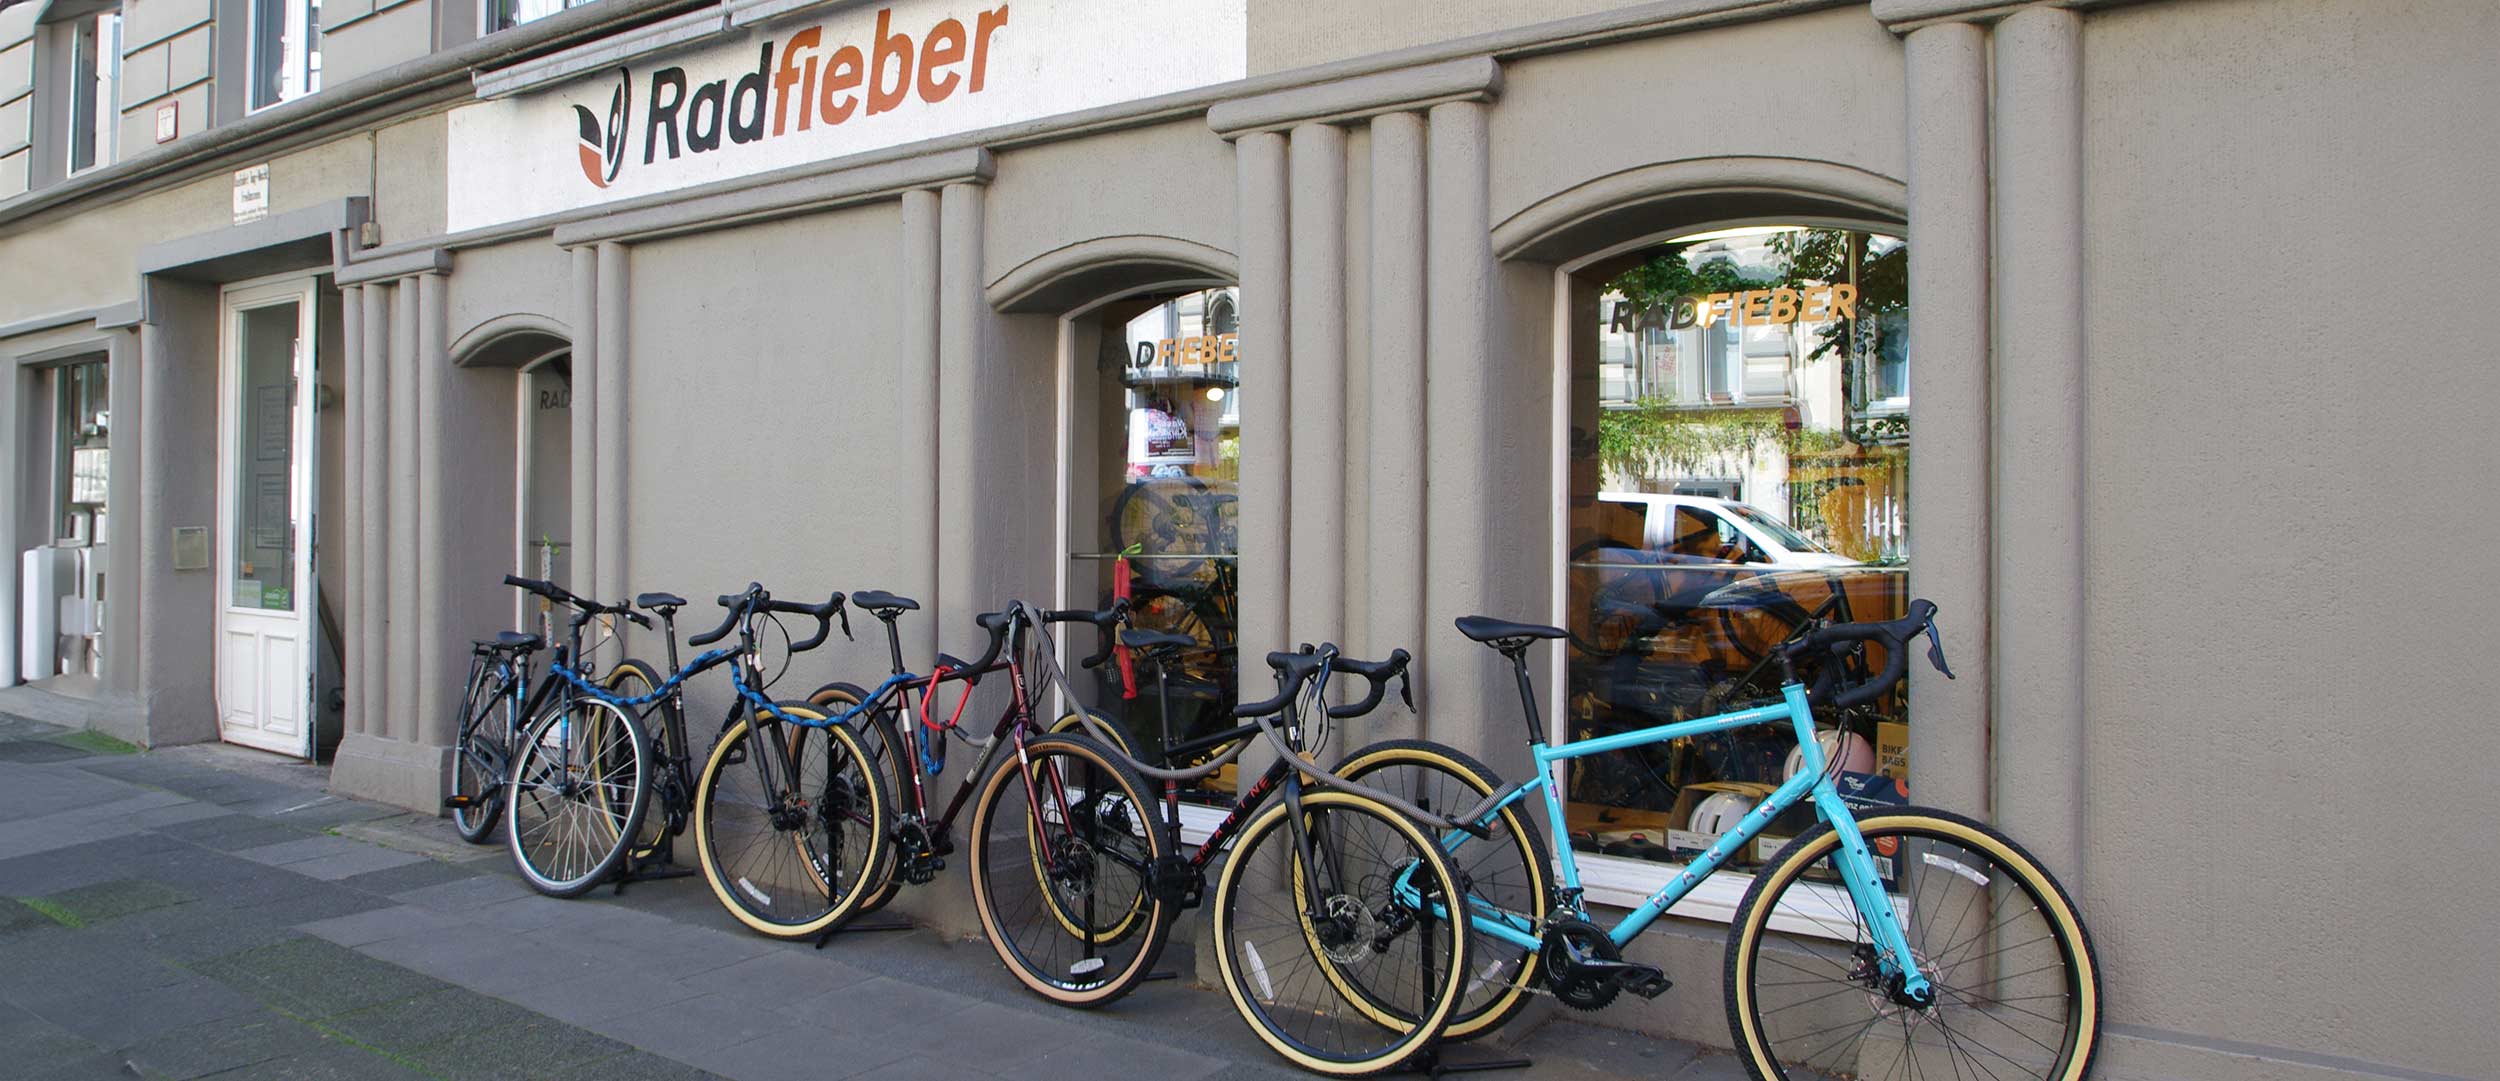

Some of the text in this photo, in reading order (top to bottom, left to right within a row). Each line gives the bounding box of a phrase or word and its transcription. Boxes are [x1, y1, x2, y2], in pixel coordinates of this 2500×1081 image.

[642, 4, 1009, 166] Radfieber
[1609, 283, 1858, 334] RADFIEBER
[1882, 744, 1903, 755] BIKE
[1882, 755, 1906, 767] BAGS
[1652, 799, 1776, 909] MARIN
